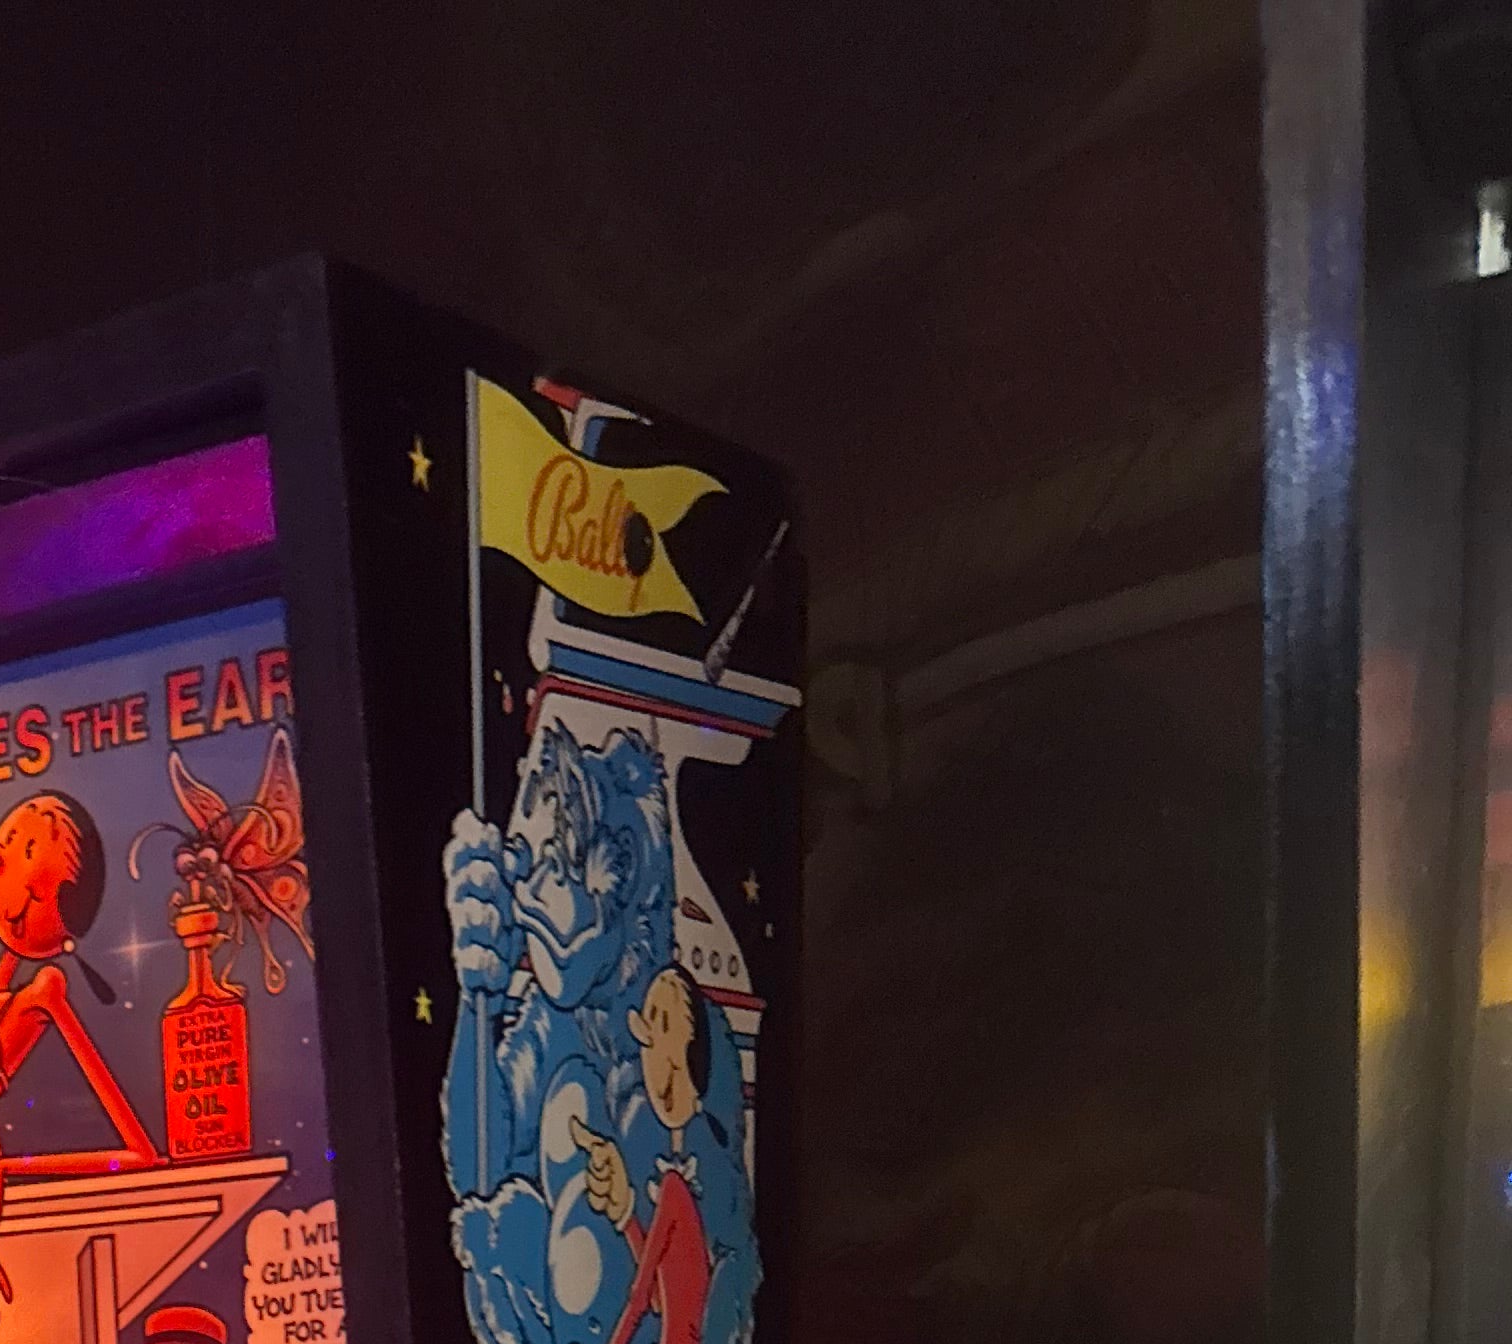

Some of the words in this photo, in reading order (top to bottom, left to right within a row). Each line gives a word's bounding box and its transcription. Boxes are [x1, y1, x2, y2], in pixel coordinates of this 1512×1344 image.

[526, 453, 644, 613] Ball
[61, 691, 150, 756] THE
[164, 646, 292, 743] EAR
[179, 1011, 226, 1028] EXTRA
[177, 1025, 232, 1048] PURE
[178, 1046, 232, 1065] VIRGIN
[173, 1060, 240, 1092] OLIVE
[185, 1093, 228, 1119] OIL
[284, 1227, 291, 1250] I
[251, 1293, 296, 1321] YOU
[301, 1289, 343, 1313] TUE
[284, 1320, 326, 1344] FOR
